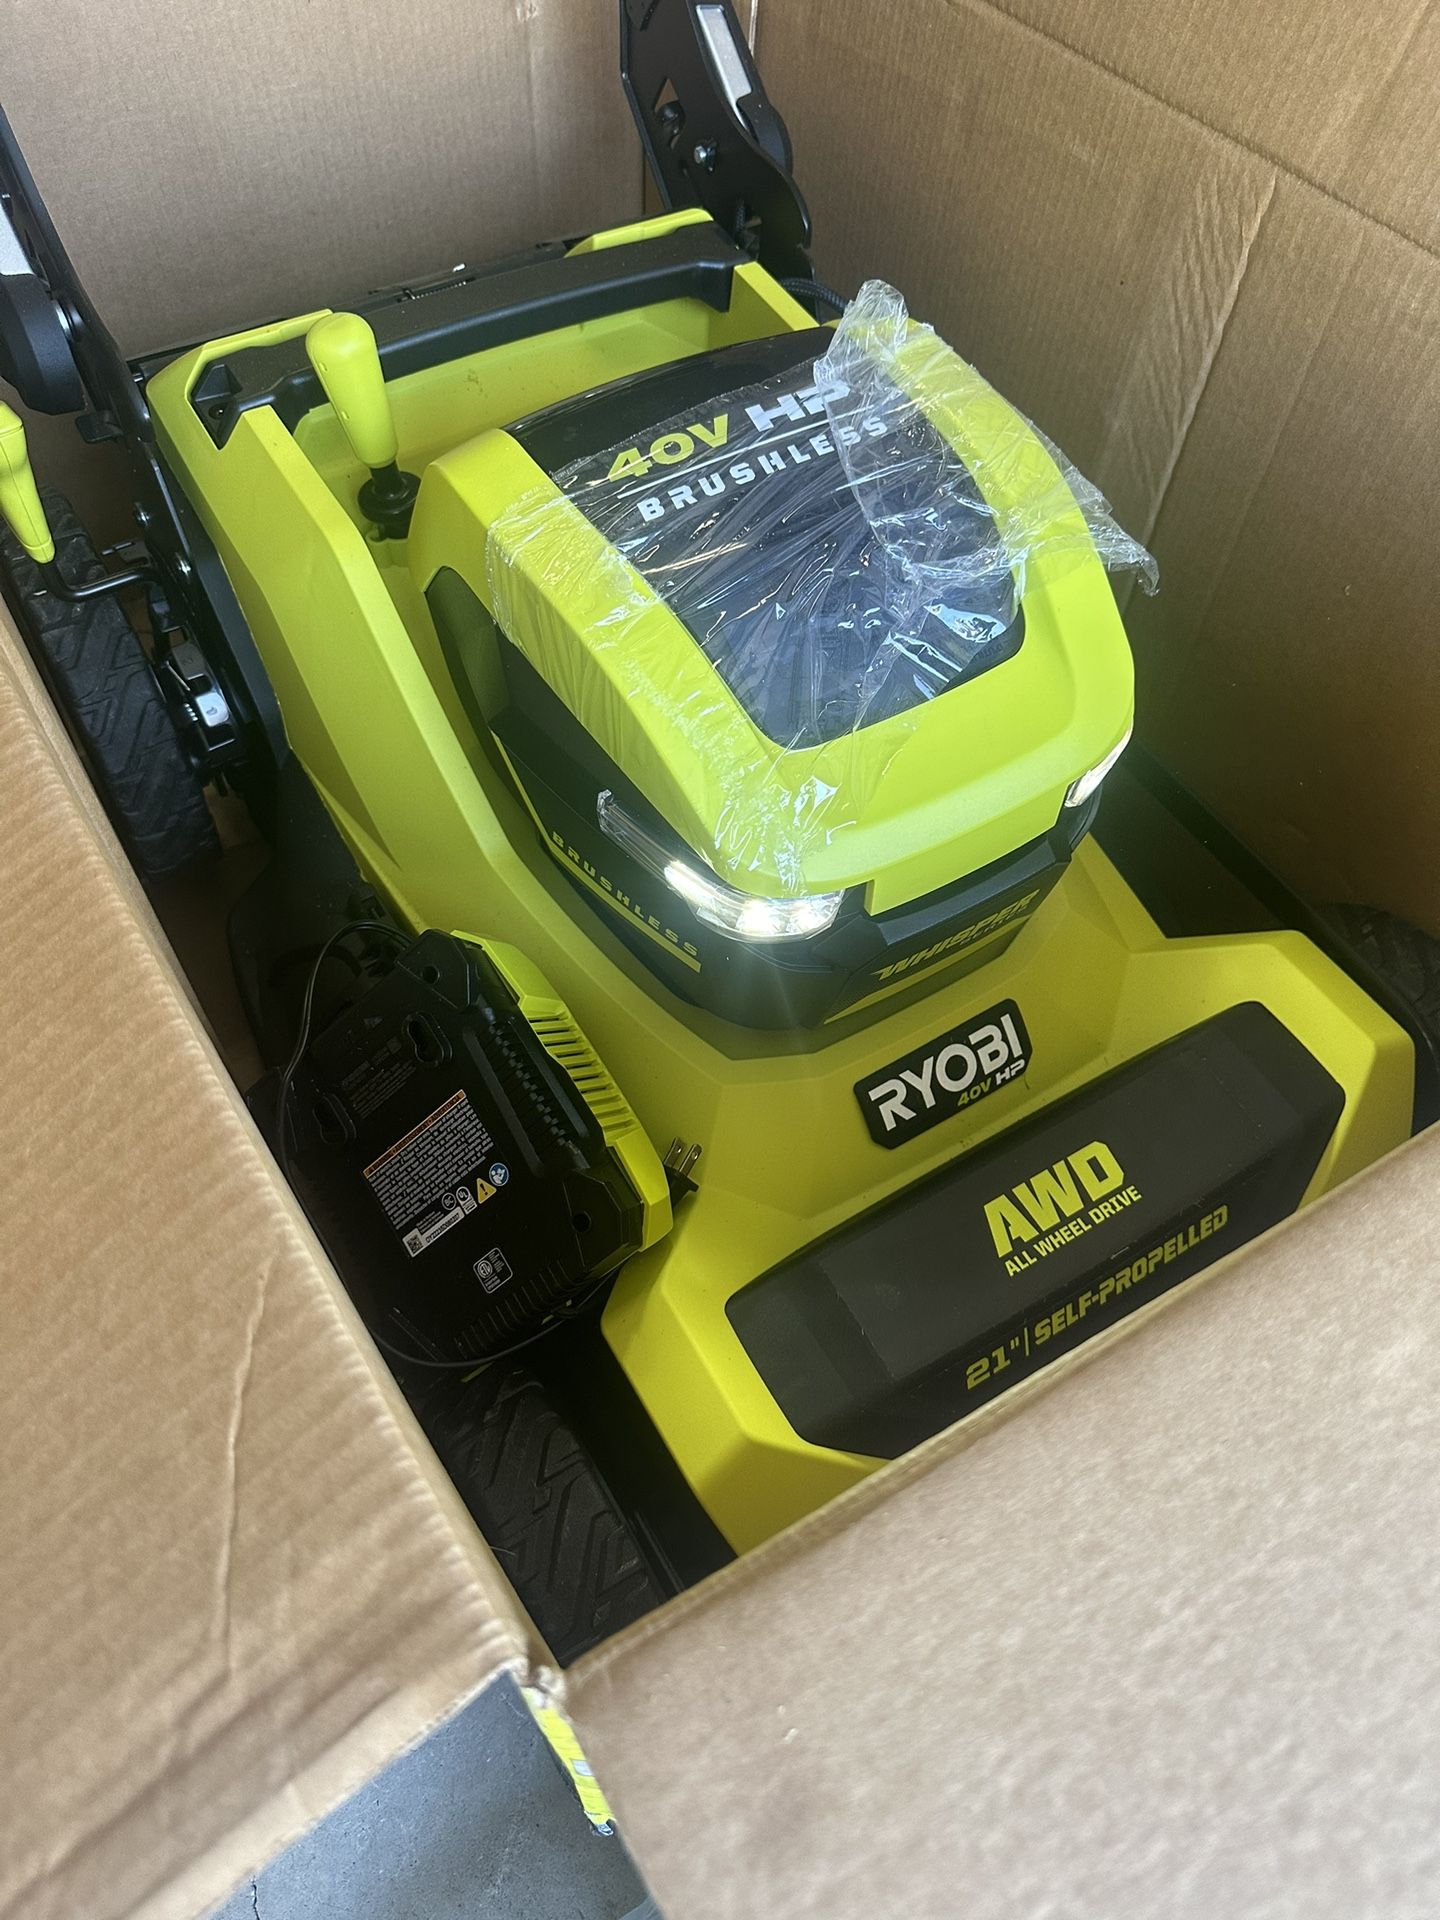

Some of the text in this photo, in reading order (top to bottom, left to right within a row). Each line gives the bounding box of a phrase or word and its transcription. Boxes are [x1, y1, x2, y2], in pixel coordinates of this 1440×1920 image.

[608, 378, 852, 484] 40V HP
[636, 416, 889, 523] BRUSHLESS
[552, 831, 698, 957] BRUSHLESS
[869, 888, 1041, 981] WHISPER
[867, 1013, 1024, 1132] RYOBI
[956, 1058, 1026, 1107] 40V HP
[983, 1140, 1126, 1259] AWD
[1004, 1184, 1142, 1278] ALL WHEEL DRIVE
[1033, 1203, 1230, 1346] SELF-PROPELLED
